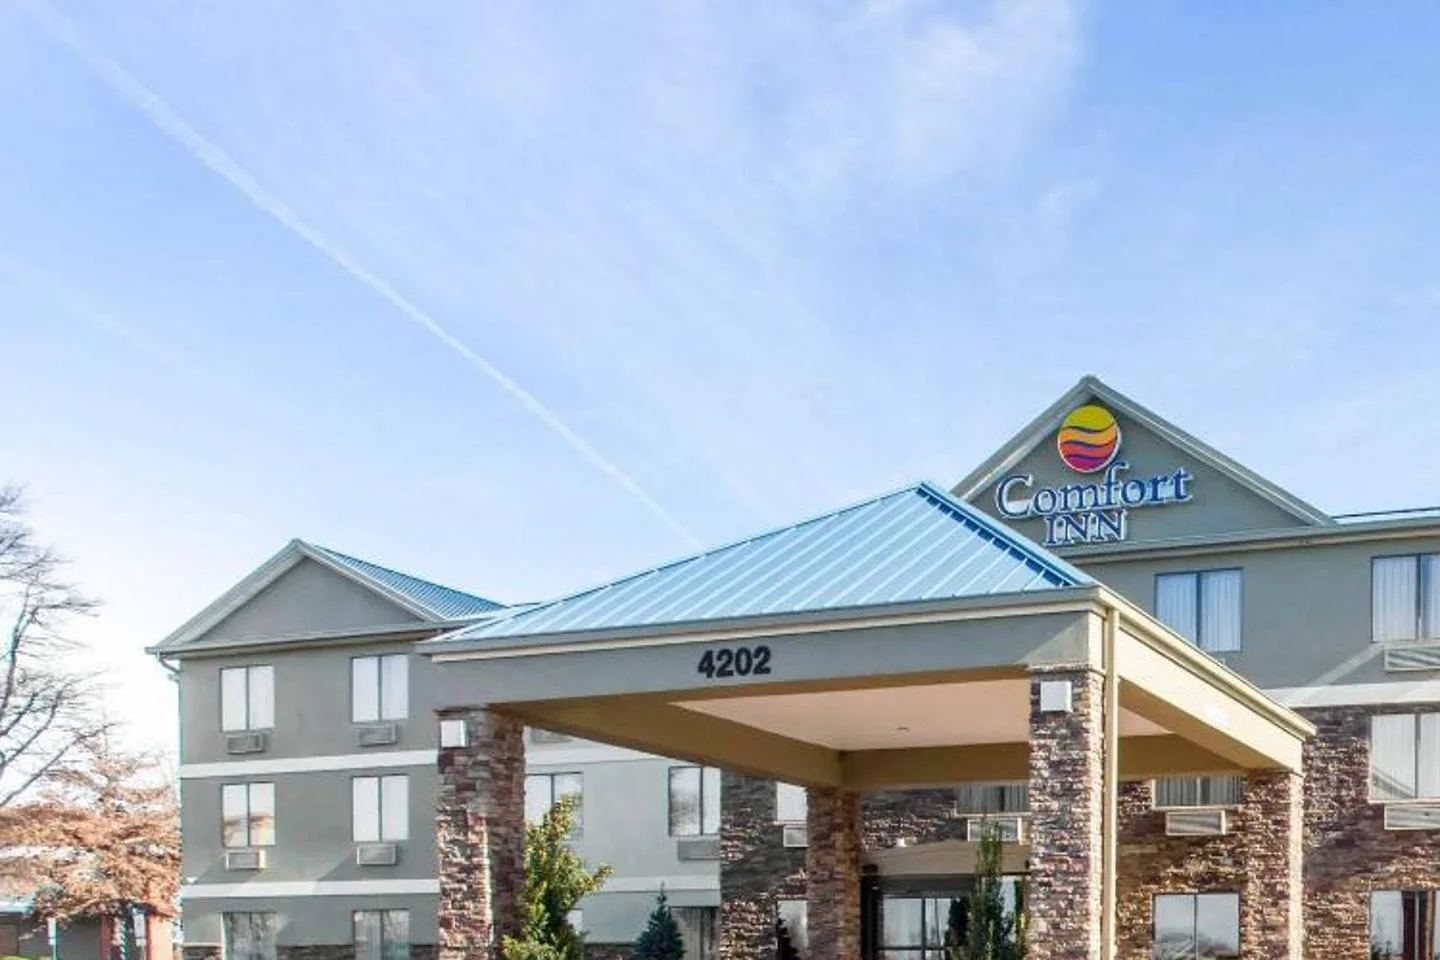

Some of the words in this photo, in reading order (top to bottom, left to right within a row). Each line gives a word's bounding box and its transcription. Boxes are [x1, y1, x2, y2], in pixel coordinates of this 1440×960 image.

[996, 461, 1192, 518] Comfort
[1044, 508, 1127, 545] INN
[697, 645, 771, 678] 4202
